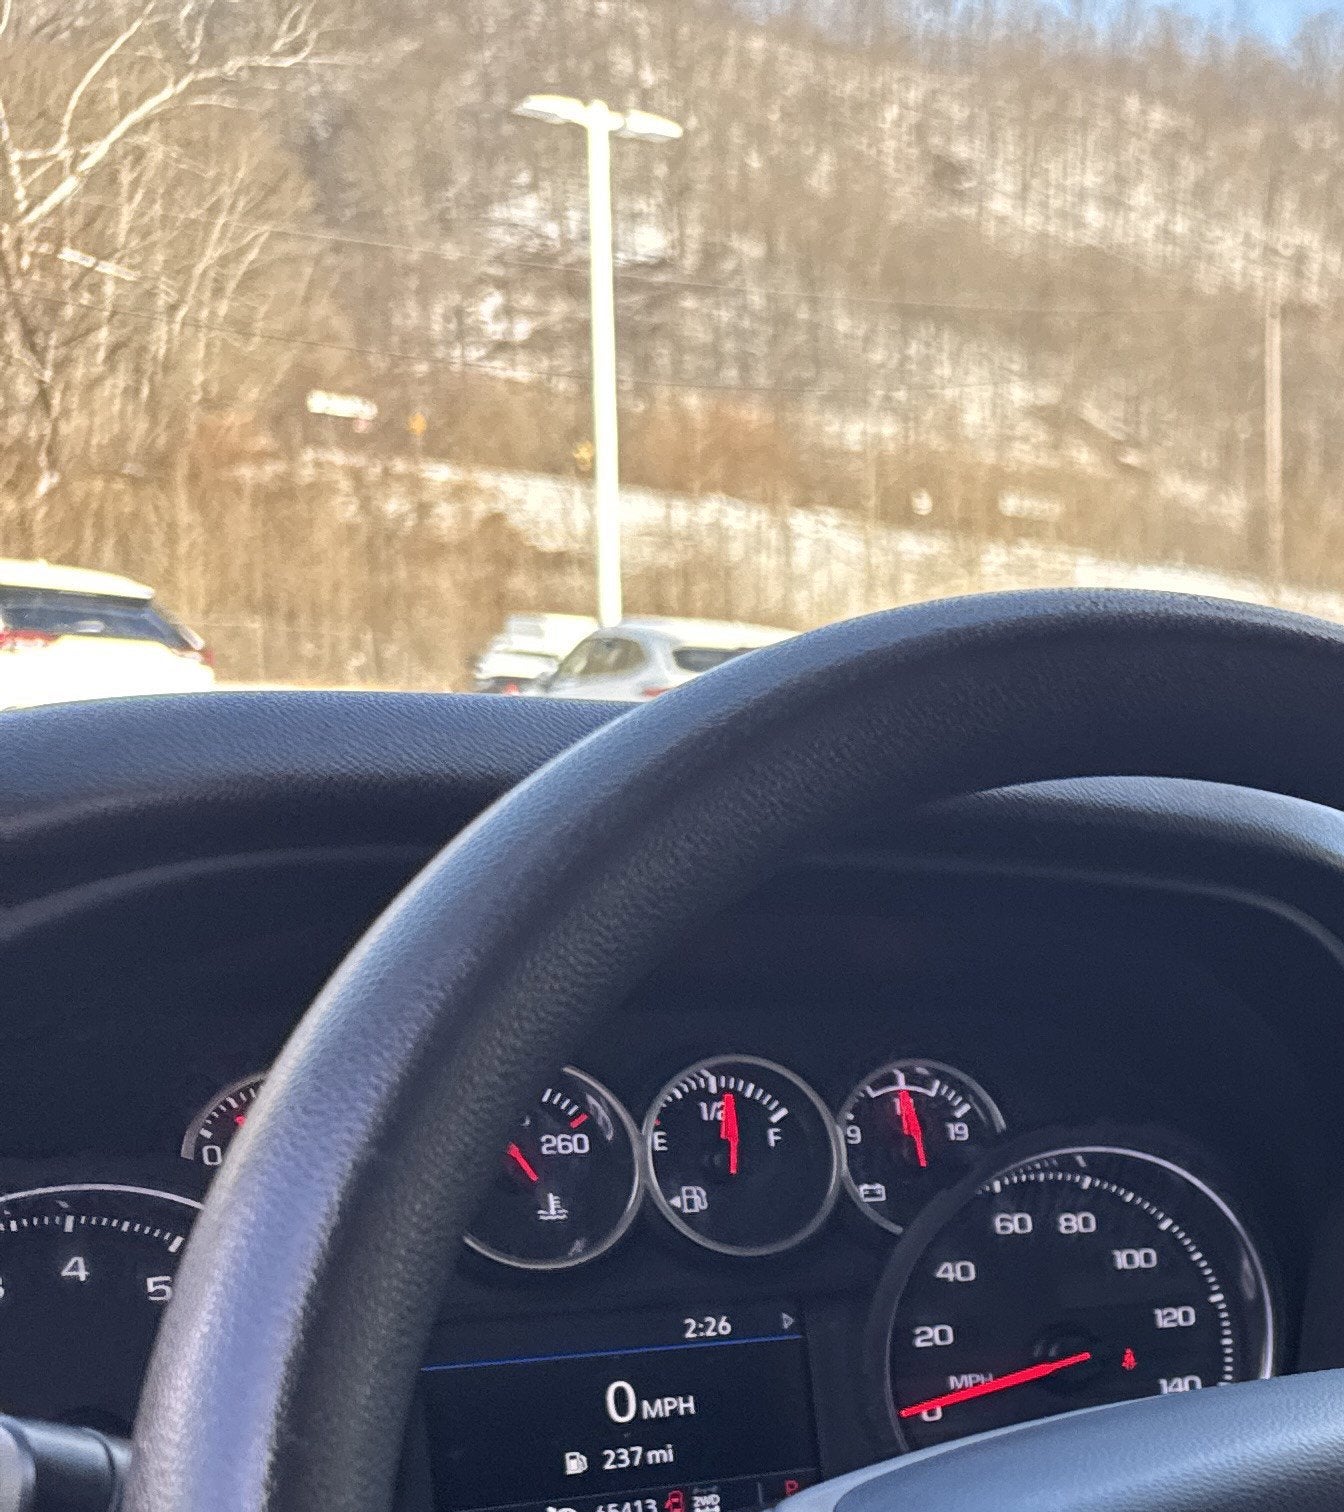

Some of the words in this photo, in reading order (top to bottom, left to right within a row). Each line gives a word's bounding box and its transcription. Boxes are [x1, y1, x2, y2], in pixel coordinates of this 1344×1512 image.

[652, 1131, 668, 1151] E
[767, 1127, 782, 1148] F
[846, 1125, 862, 1145] 9
[945, 1121, 970, 1142] 19
[540, 1133, 590, 1155] 260
[994, 1212, 1033, 1235] 60
[1058, 1211, 1097, 1235] 80
[61, 1256, 90, 1282] 4
[1111, 1248, 1157, 1271] 100
[934, 1260, 976, 1283] 40
[146, 1275, 173, 1302] 5
[683, 1315, 732, 1339] 2:26
[1154, 1305, 1196, 1329] 120
[913, 1324, 954, 1348] 20
[606, 1380, 637, 1423] 0
[641, 1395, 697, 1420] MPH
[602, 1445, 643, 1470] 237
[646, 1443, 674, 1466] mi
